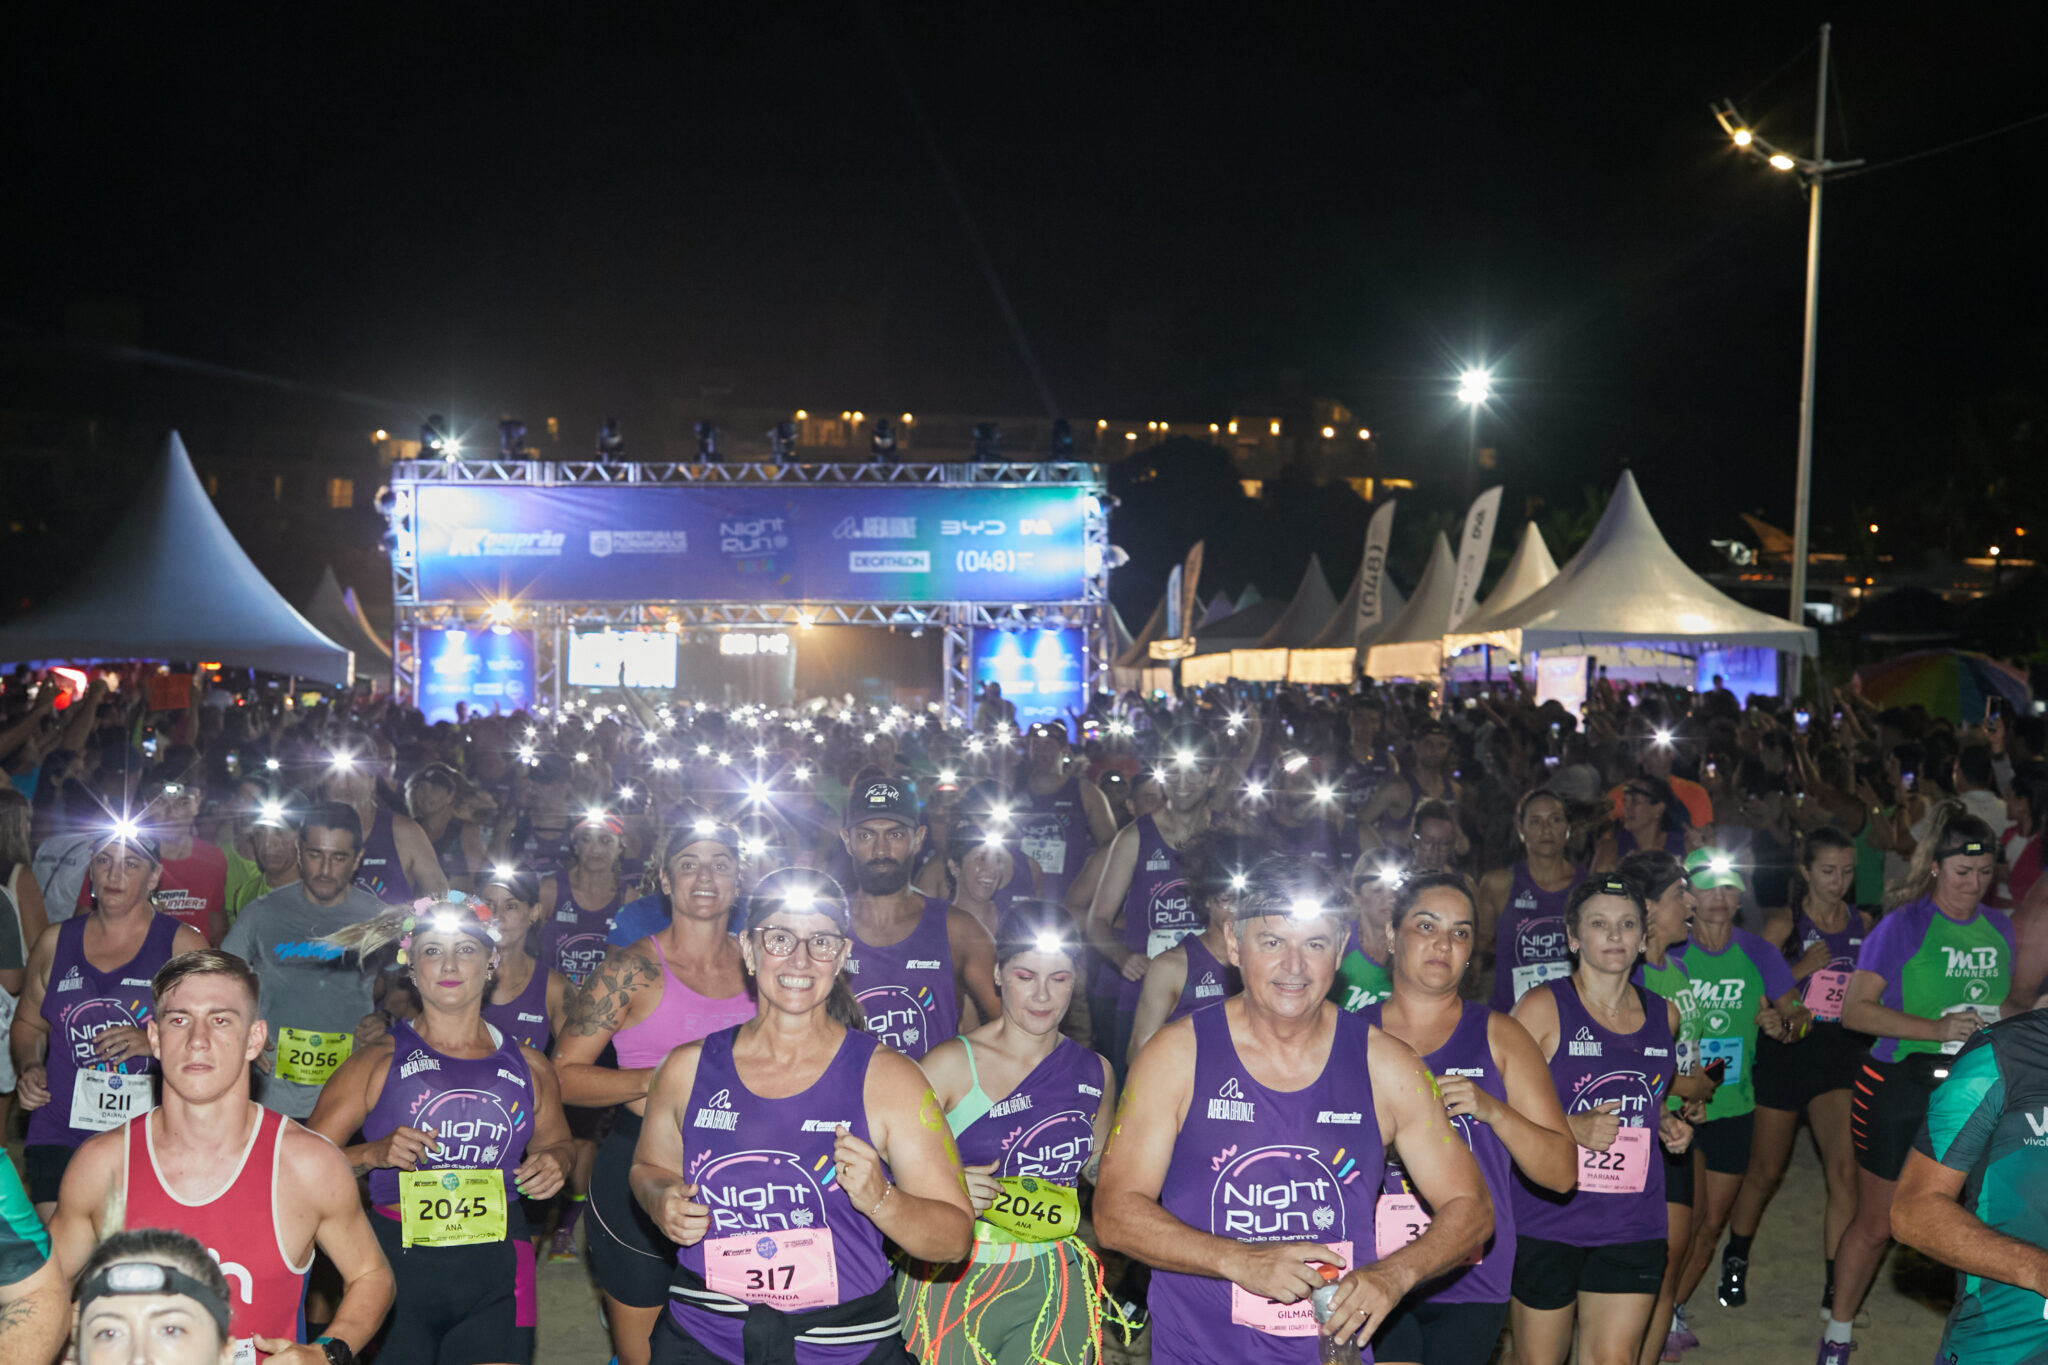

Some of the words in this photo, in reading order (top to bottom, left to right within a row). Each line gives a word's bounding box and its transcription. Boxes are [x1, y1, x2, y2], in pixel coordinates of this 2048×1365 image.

[719, 517, 786, 537] Night
[940, 519, 1006, 536] BYD
[721, 536, 773, 552] Run
[854, 556, 925, 568] DECATHLON
[956, 550, 1015, 572] (048)
[1361, 544, 1384, 618] (048)
[1032, 849, 1054, 861] 1516
[1155, 911, 1195, 923] Run
[1521, 932, 1565, 947] Nigh
[560, 949, 606, 962] Nigh
[1523, 947, 1561, 958] Run
[1941, 946, 1998, 969] MB
[1945, 969, 1999, 978] RUNNERS
[1347, 985, 1392, 1009] M
[1689, 979, 1746, 1001] MB
[1699, 1000, 1743, 1009] NNERS
[863, 1008, 917, 1032] ight
[289, 1049, 337, 1067] 2056
[400, 1060, 420, 1079] AREIA
[418, 1058, 442, 1072] BRONZE
[99, 1092, 131, 1111] 1211
[989, 1100, 1011, 1119] AREIA
[1009, 1095, 1034, 1113] BRONZE
[1207, 1098, 1230, 1120] AREIA
[1229, 1100, 1255, 1122] BRONZE
[693, 1108, 715, 1128] AREIA
[713, 1111, 740, 1131] BRONZE
[421, 1119, 508, 1142] Night
[424, 1141, 481, 1163] Run
[2023, 1137, 2048, 1147] viva
[1018, 1160, 1082, 1177] Run
[1583, 1150, 1626, 1171] 222
[1587, 1173, 1620, 1181] MARIANA
[701, 1182, 811, 1211] Night
[1224, 1178, 1330, 1210] Night
[418, 1196, 488, 1221] 2045
[994, 1192, 1062, 1225] 2046
[444, 1223, 463, 1232] ANA
[713, 1208, 789, 1231] Run
[1015, 1220, 1032, 1230] ANA
[1225, 1210, 1309, 1234] Run
[746, 1264, 796, 1291] 317
[745, 1293, 800, 1301] FERNANDA
[1277, 1310, 1314, 1319] GILMAR
